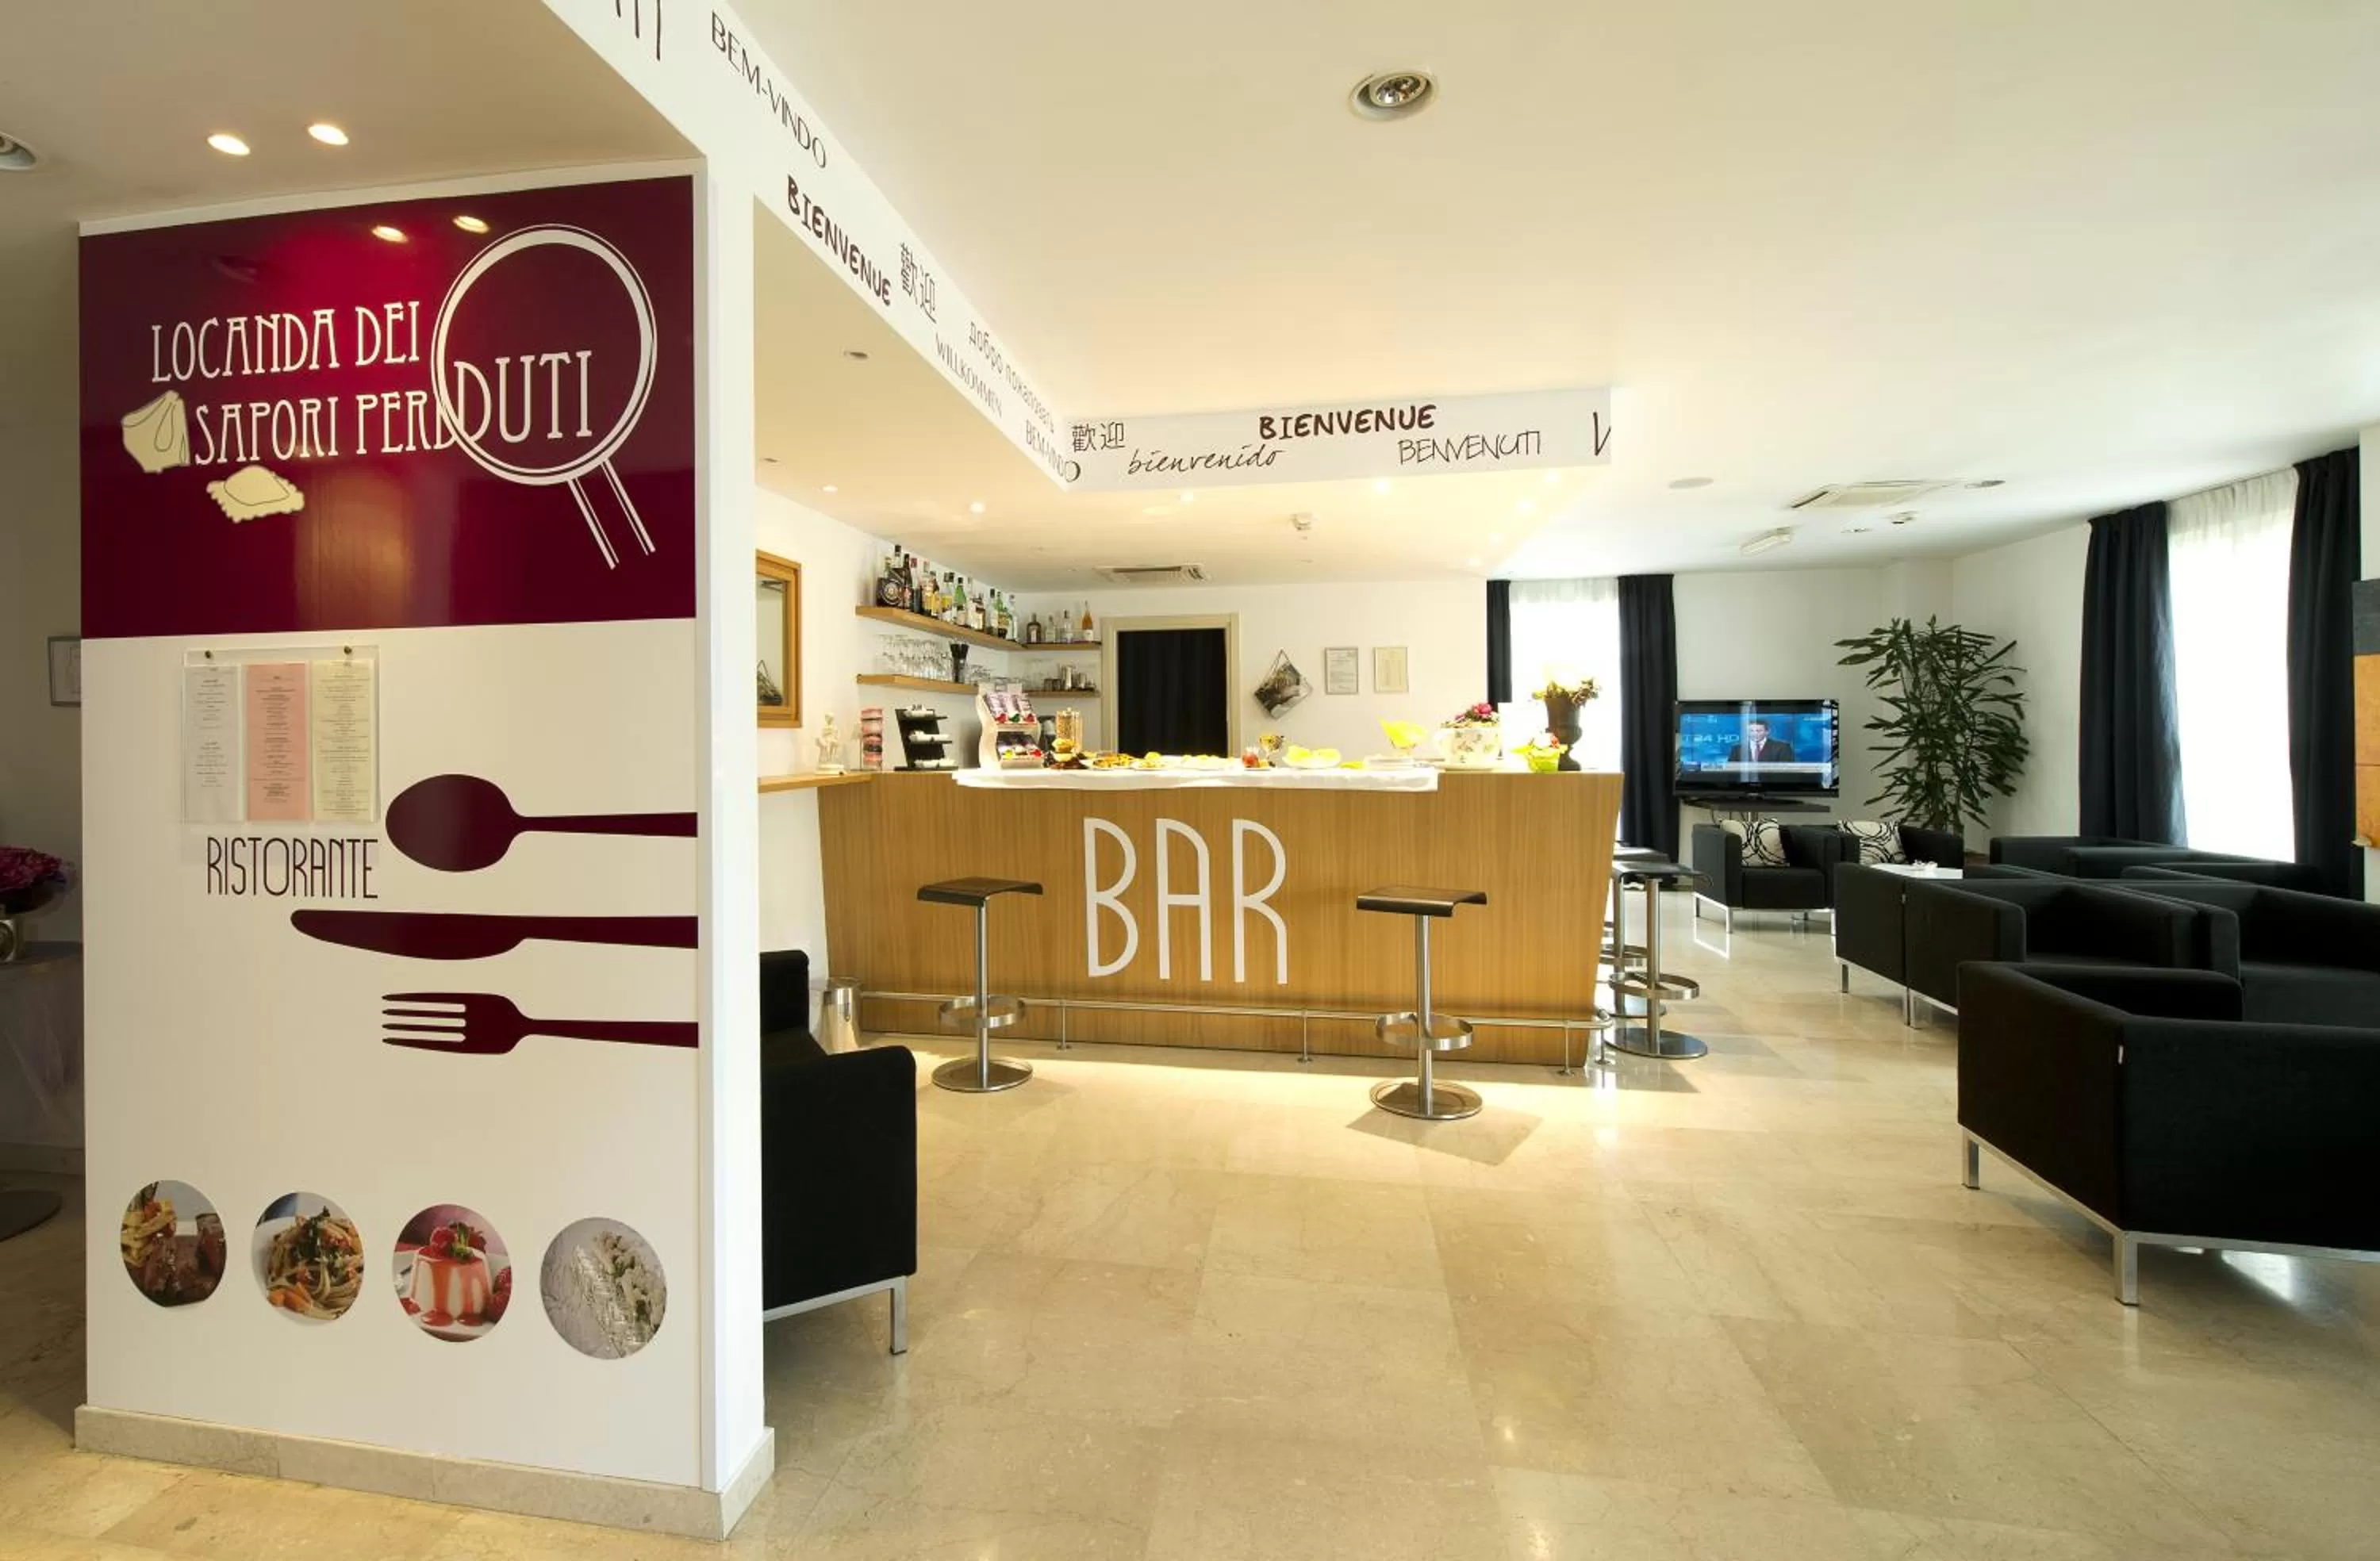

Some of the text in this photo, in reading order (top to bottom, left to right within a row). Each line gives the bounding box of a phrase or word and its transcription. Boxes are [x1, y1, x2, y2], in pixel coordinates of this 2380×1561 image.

[711, 11, 827, 169] BEM-VINDO
[786, 175, 892, 307] BIENVENUE
[900, 241, 937, 324] 歡迎
[152, 301, 420, 382] LOCANDA DEI
[935, 332, 1003, 419] WILLKOMMEN
[195, 397, 340, 466] SAPORI
[1072, 421, 1125, 453] 歡迎
[1128, 443, 1287, 474] bienvenido
[1259, 405, 1437, 440] BIENVENUE
[1398, 431, 1541, 465] BENVENUTI
[207, 837, 378, 899] RISTORANTE
[1083, 816, 1288, 985] BAR
